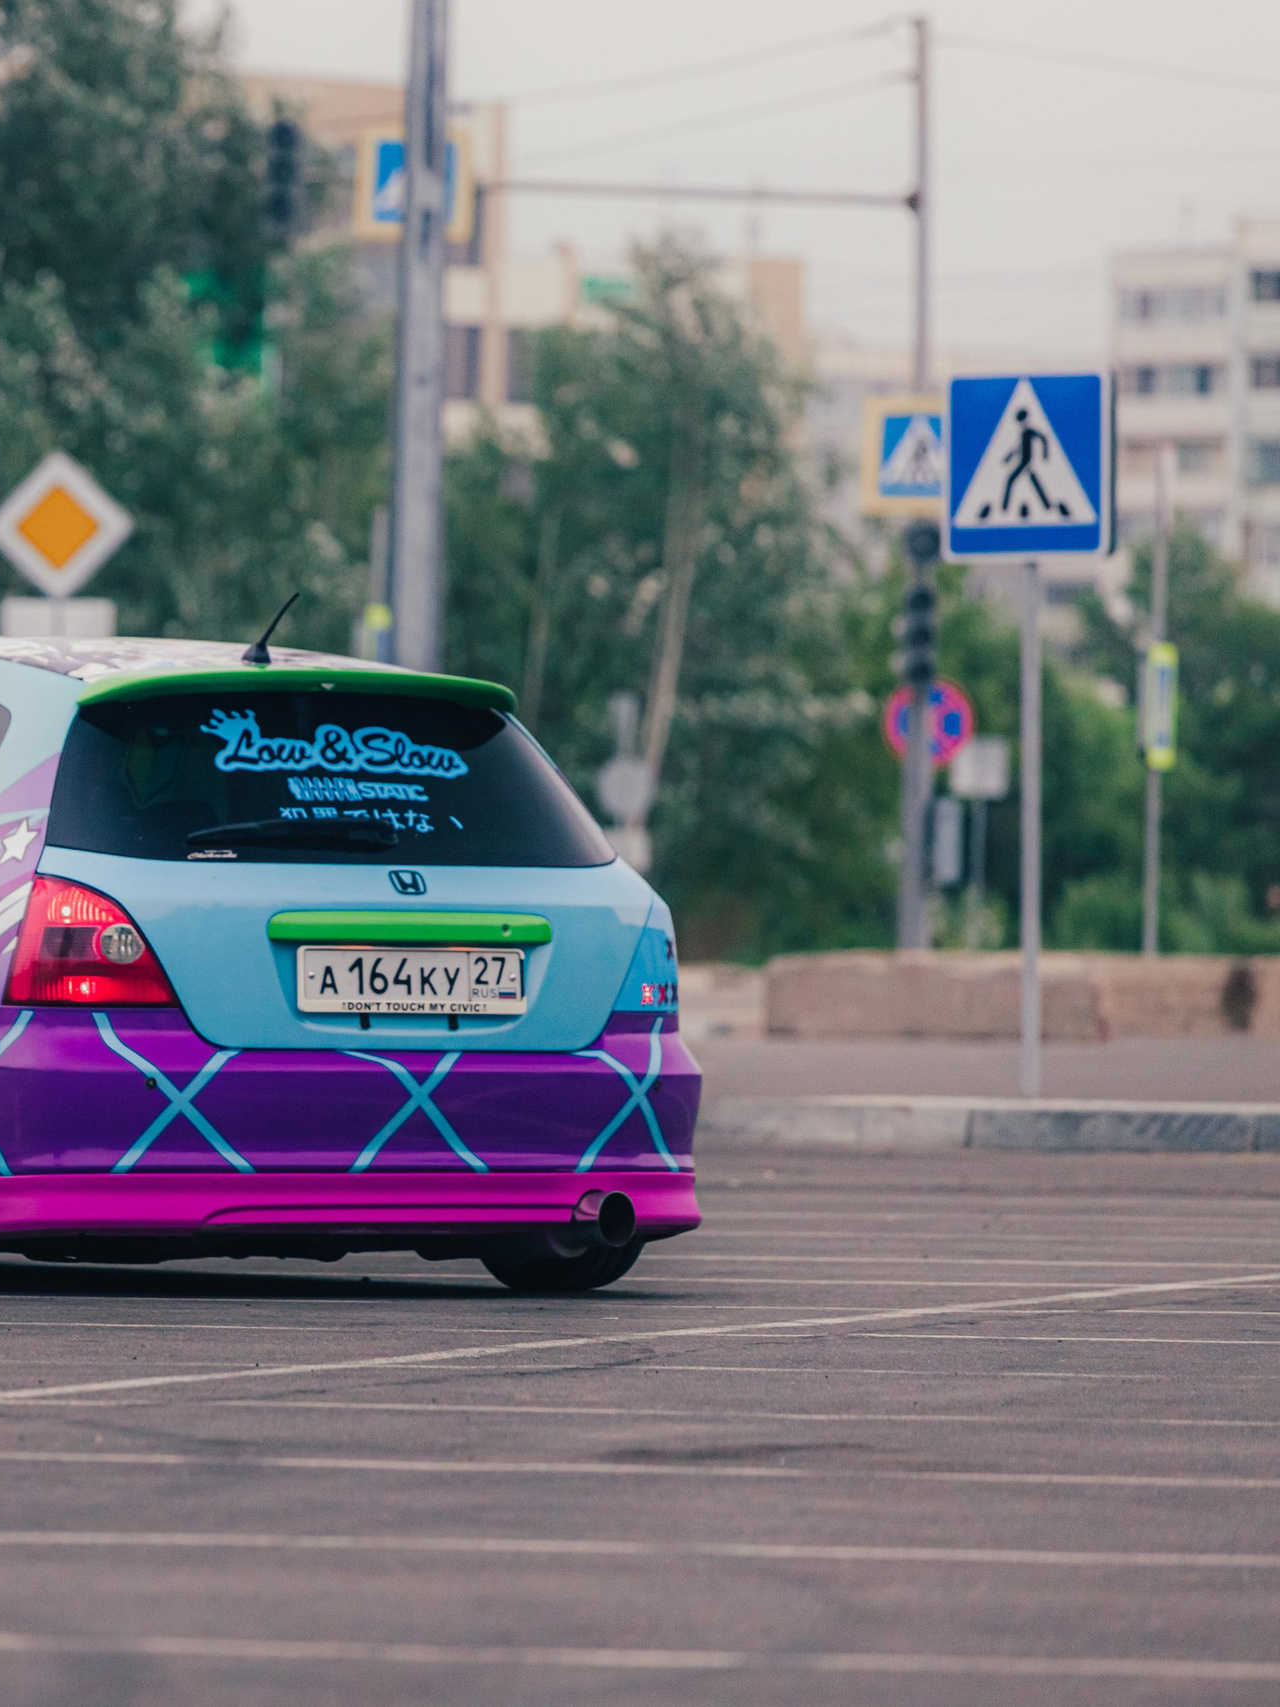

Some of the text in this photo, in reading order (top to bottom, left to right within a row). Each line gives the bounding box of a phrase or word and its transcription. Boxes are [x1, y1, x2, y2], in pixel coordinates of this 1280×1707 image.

[223, 728, 461, 772] Low & Slow
[358, 782, 429, 801] STATIC
[474, 956, 506, 985] 27
[472, 988, 497, 998] RUS
[386, 1002, 425, 1011] TOUCH
[429, 1003, 446, 1011] MY
